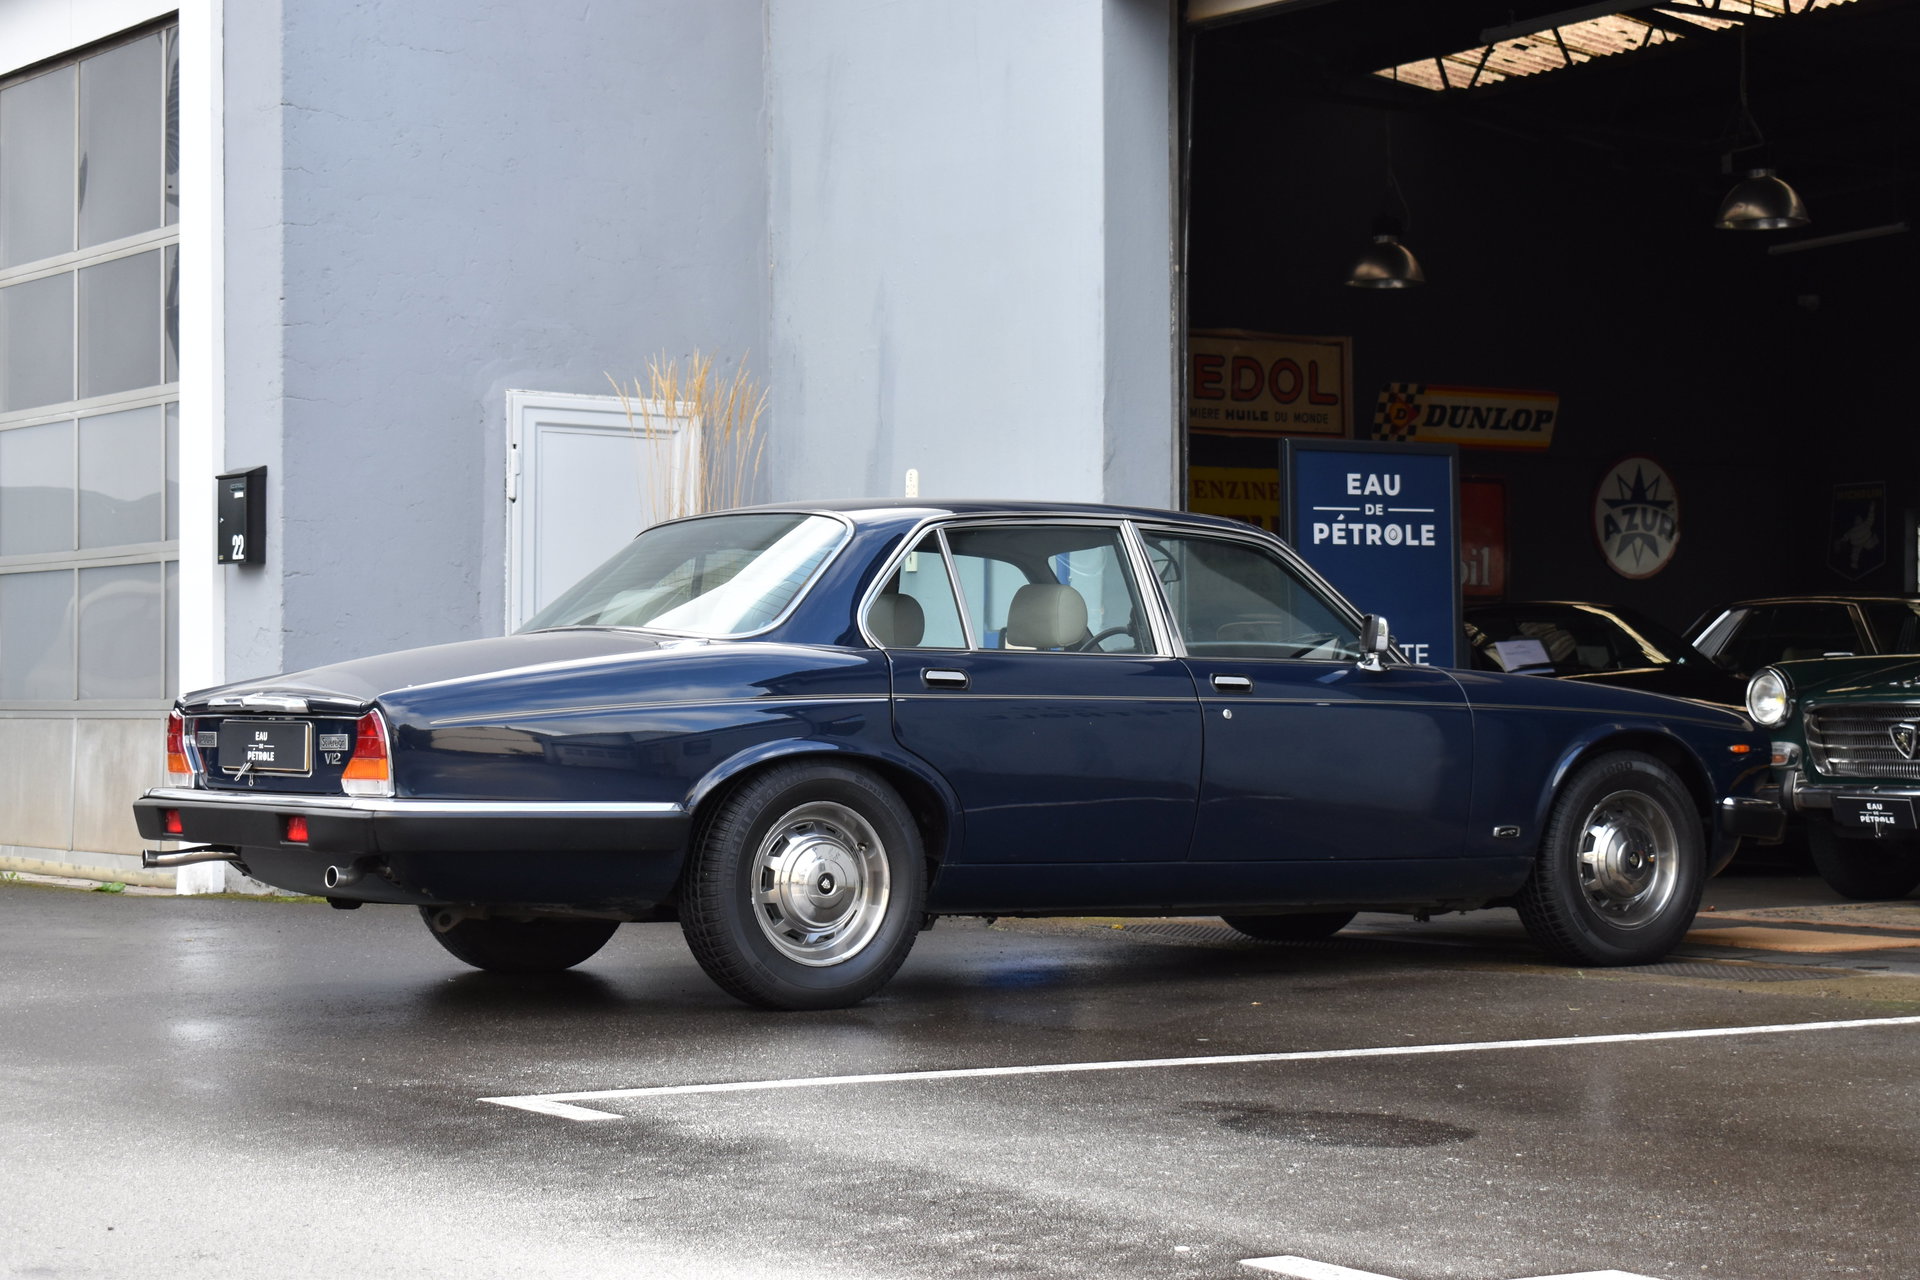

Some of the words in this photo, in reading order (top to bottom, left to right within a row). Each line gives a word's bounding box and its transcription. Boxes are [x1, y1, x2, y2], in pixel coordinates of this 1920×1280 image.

[1193, 353, 1339, 406] EDOL
[1225, 409, 1269, 422] HUILE
[1274, 411, 1288, 423] DU
[1293, 412, 1328, 425] MONDE
[1395, 408, 1407, 420] D
[1422, 404, 1554, 432] DUNLOP
[1347, 473, 1401, 496] EAU
[1365, 503, 1384, 516] DE
[1313, 513, 1436, 546] PÉTROLE
[1603, 506, 1675, 543] AZUR
[232, 534, 244, 560] 22
[255, 731, 268, 741] EAU
[247, 747, 275, 761] PÉTROLE
[324, 752, 341, 765] V12
[1866, 802, 1883, 811] EAU
[1860, 813, 1895, 824] PÉTROLE
